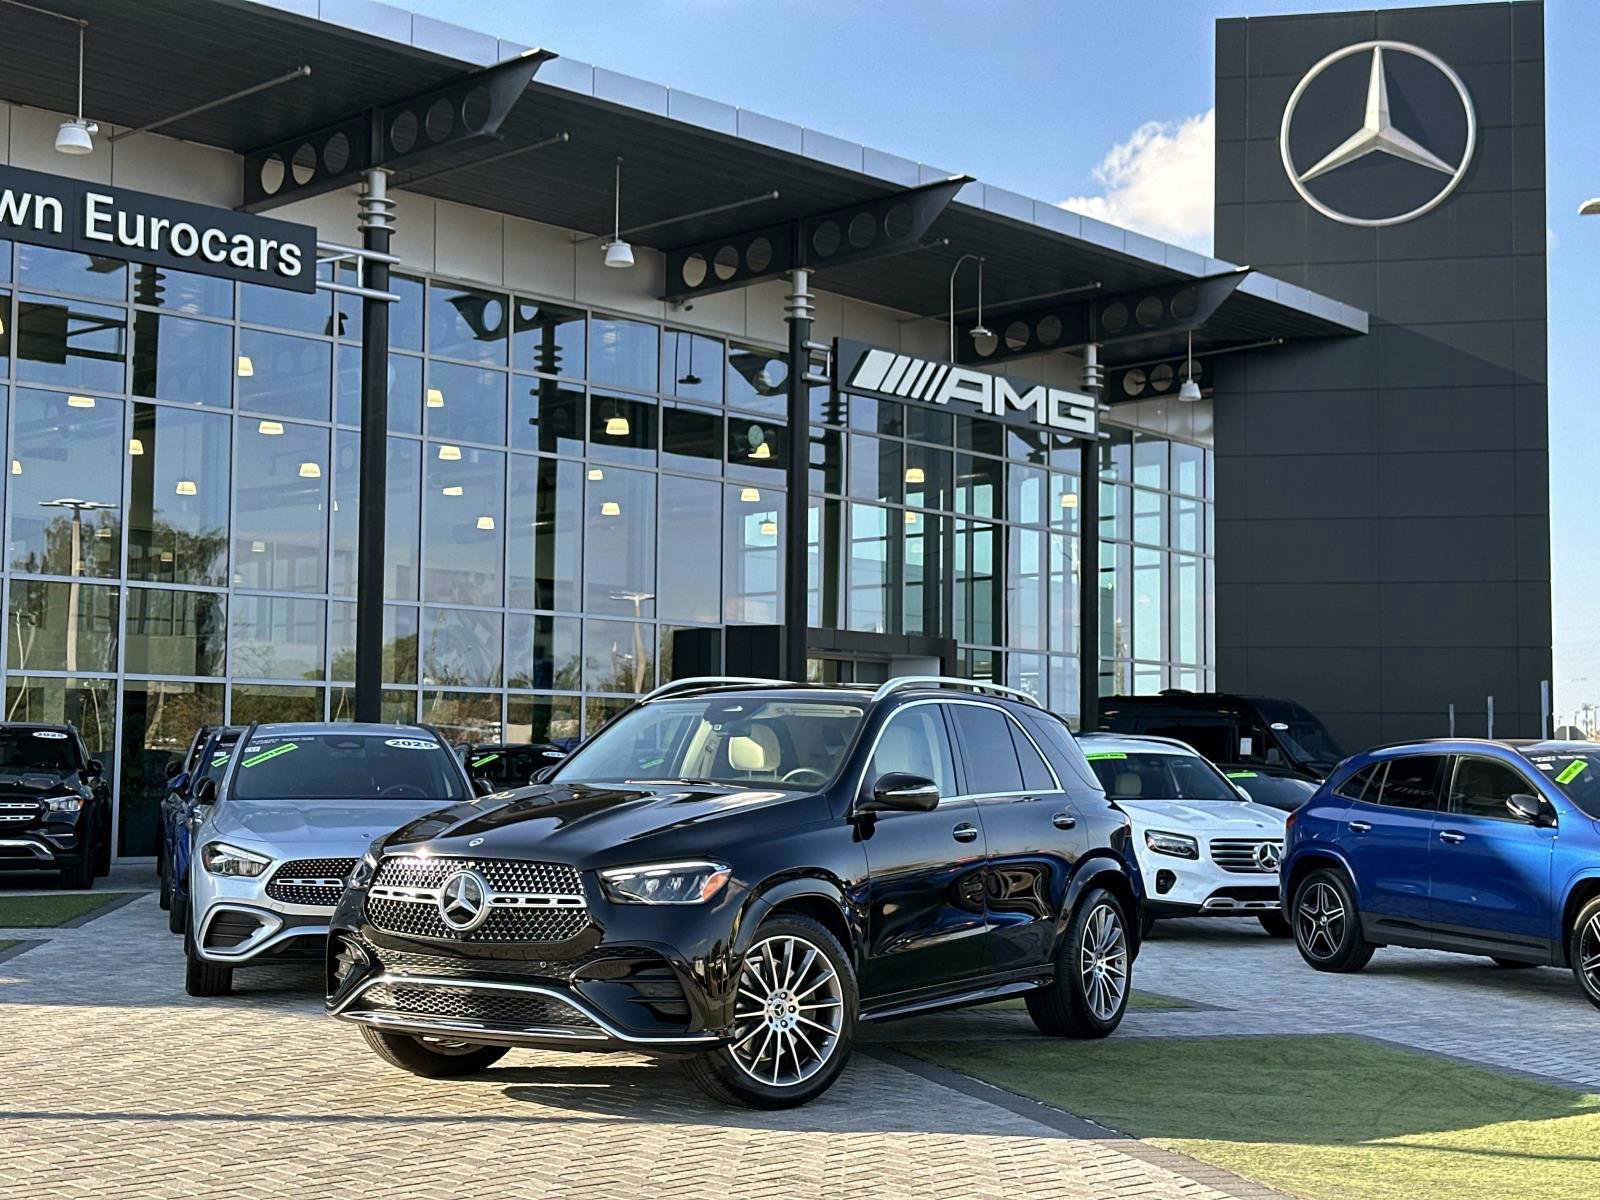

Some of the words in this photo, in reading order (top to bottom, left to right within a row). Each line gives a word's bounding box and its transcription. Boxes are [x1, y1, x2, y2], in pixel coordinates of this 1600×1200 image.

[85, 191, 303, 277] Eurocars
[935, 366, 1096, 434] AMG
[390, 740, 435, 748] 2025
